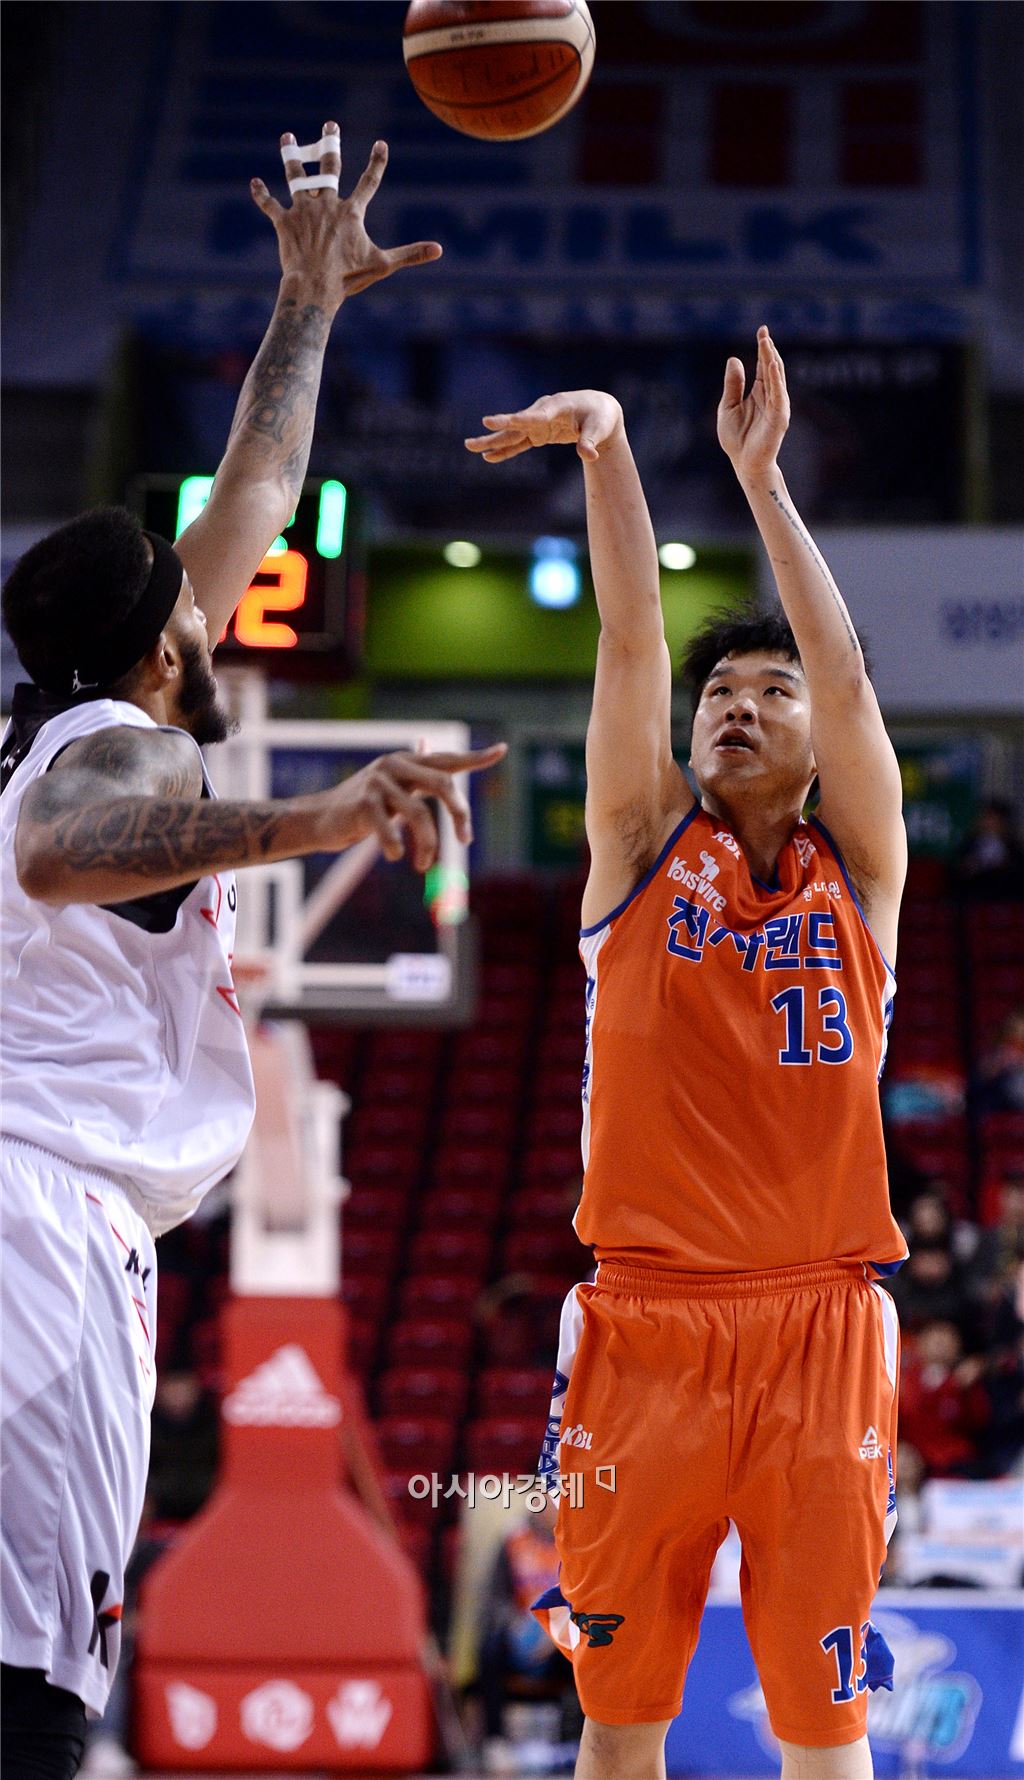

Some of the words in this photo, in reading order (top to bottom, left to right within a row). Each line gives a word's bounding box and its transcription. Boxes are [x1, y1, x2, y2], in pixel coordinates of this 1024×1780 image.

[218, 550, 308, 648] 2
[666, 895, 843, 972] 전자랜드
[770, 985, 854, 1066] 13
[560, 1423, 593, 1451] KBL
[858, 1444, 884, 1461] PEK
